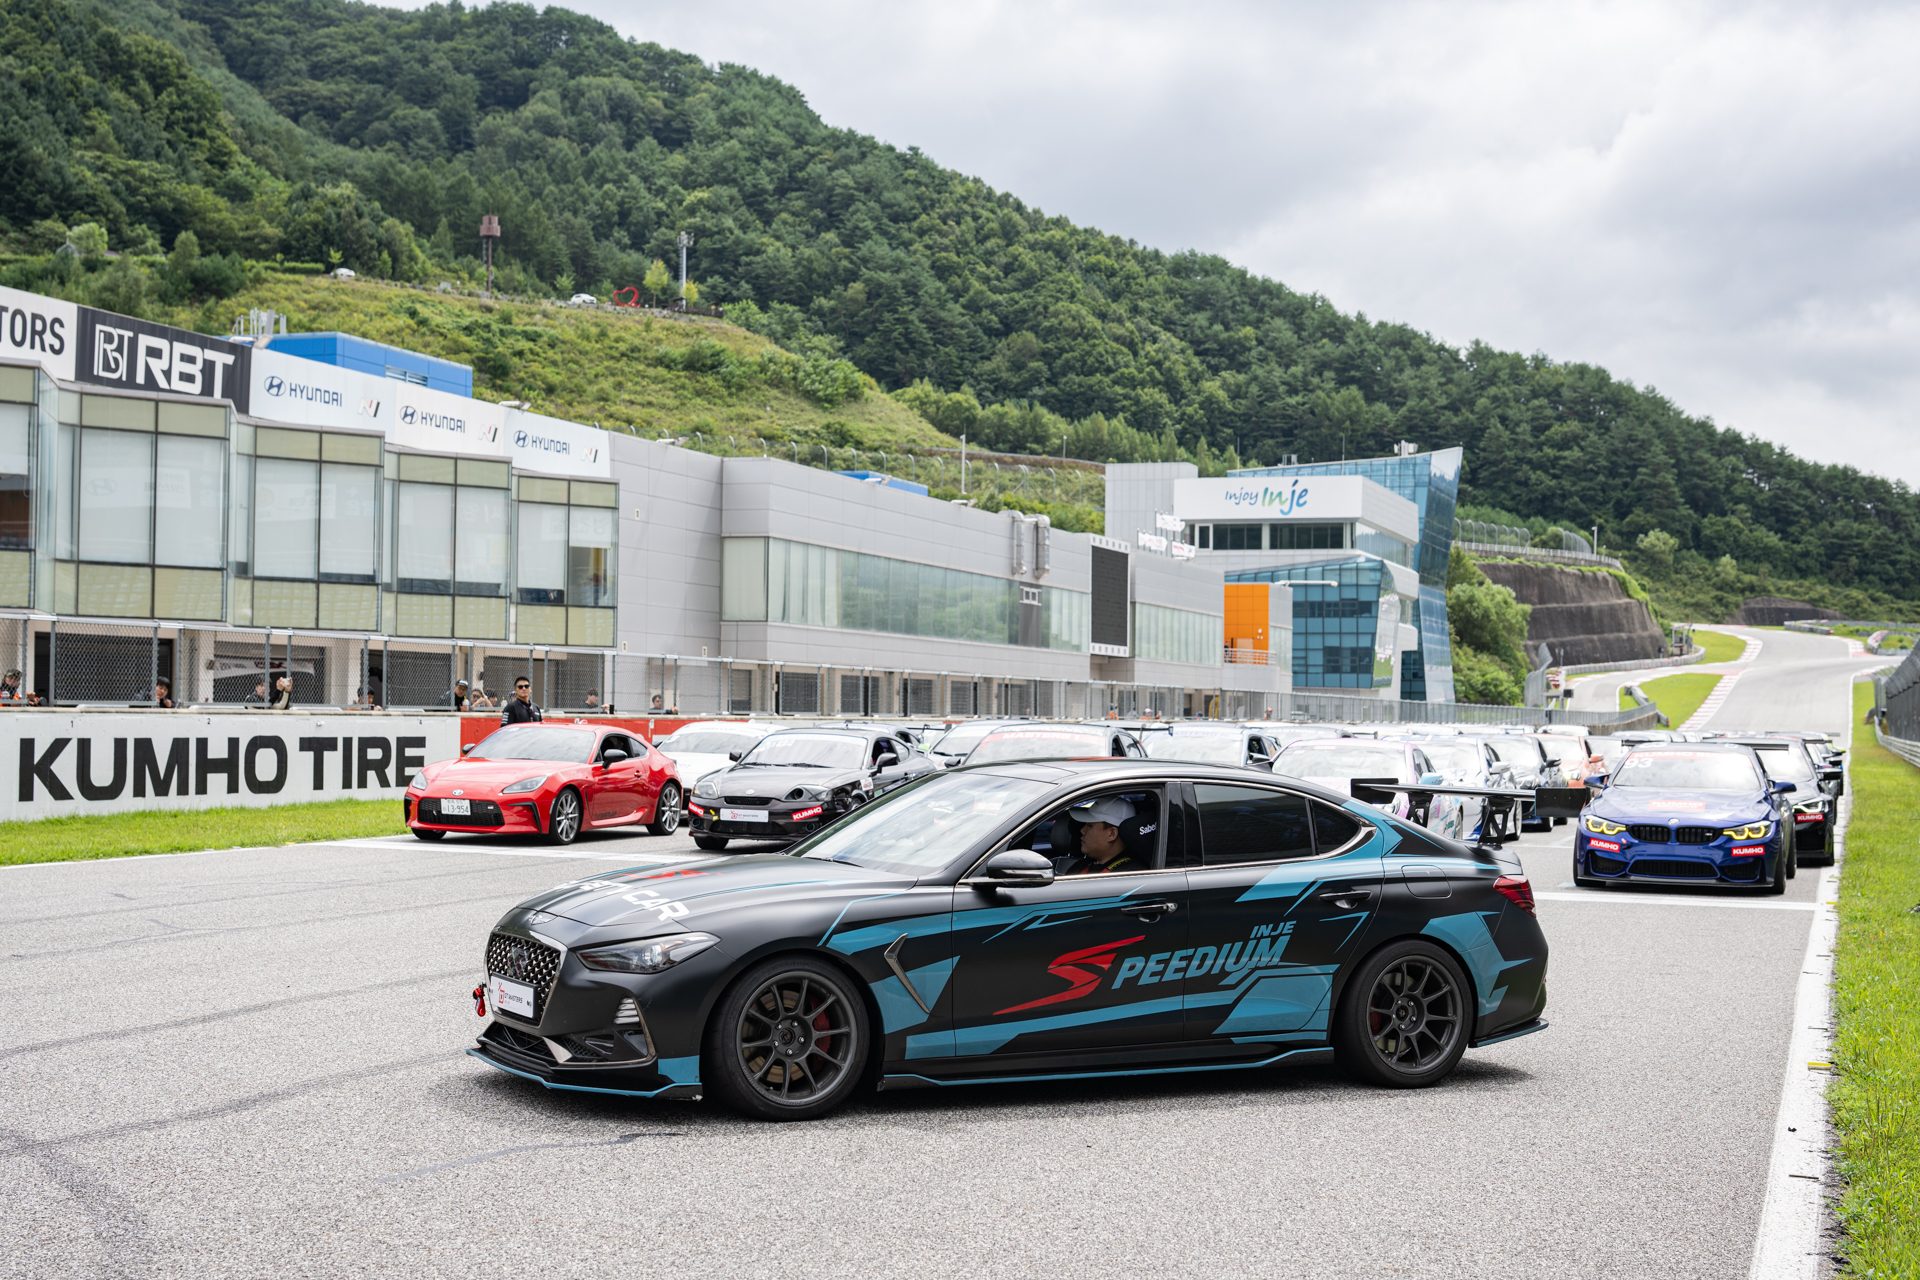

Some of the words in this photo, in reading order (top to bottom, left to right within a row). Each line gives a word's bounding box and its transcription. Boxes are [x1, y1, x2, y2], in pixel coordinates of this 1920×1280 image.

[135, 334, 236, 399] RBT
[289, 382, 343, 407] HYUNDAI
[421, 411, 466, 433] HYUNDAI
[531, 435, 570, 455] HYUNDAI
[1225, 487, 1259, 506] Injoy
[1261, 479, 1309, 516] Inje
[18, 735, 289, 802] KUMHO
[298, 735, 427, 791] TIRE
[792, 806, 822, 820] KUMHO
[1797, 814, 1823, 822] KUMHO
[1590, 839, 1619, 851] KUMHO
[1732, 847, 1764, 855] KUMHO
[622, 889, 690, 922] CAR
[1250, 920, 1297, 939] INJE
[992, 934, 1292, 1016] SPEEDIUM
